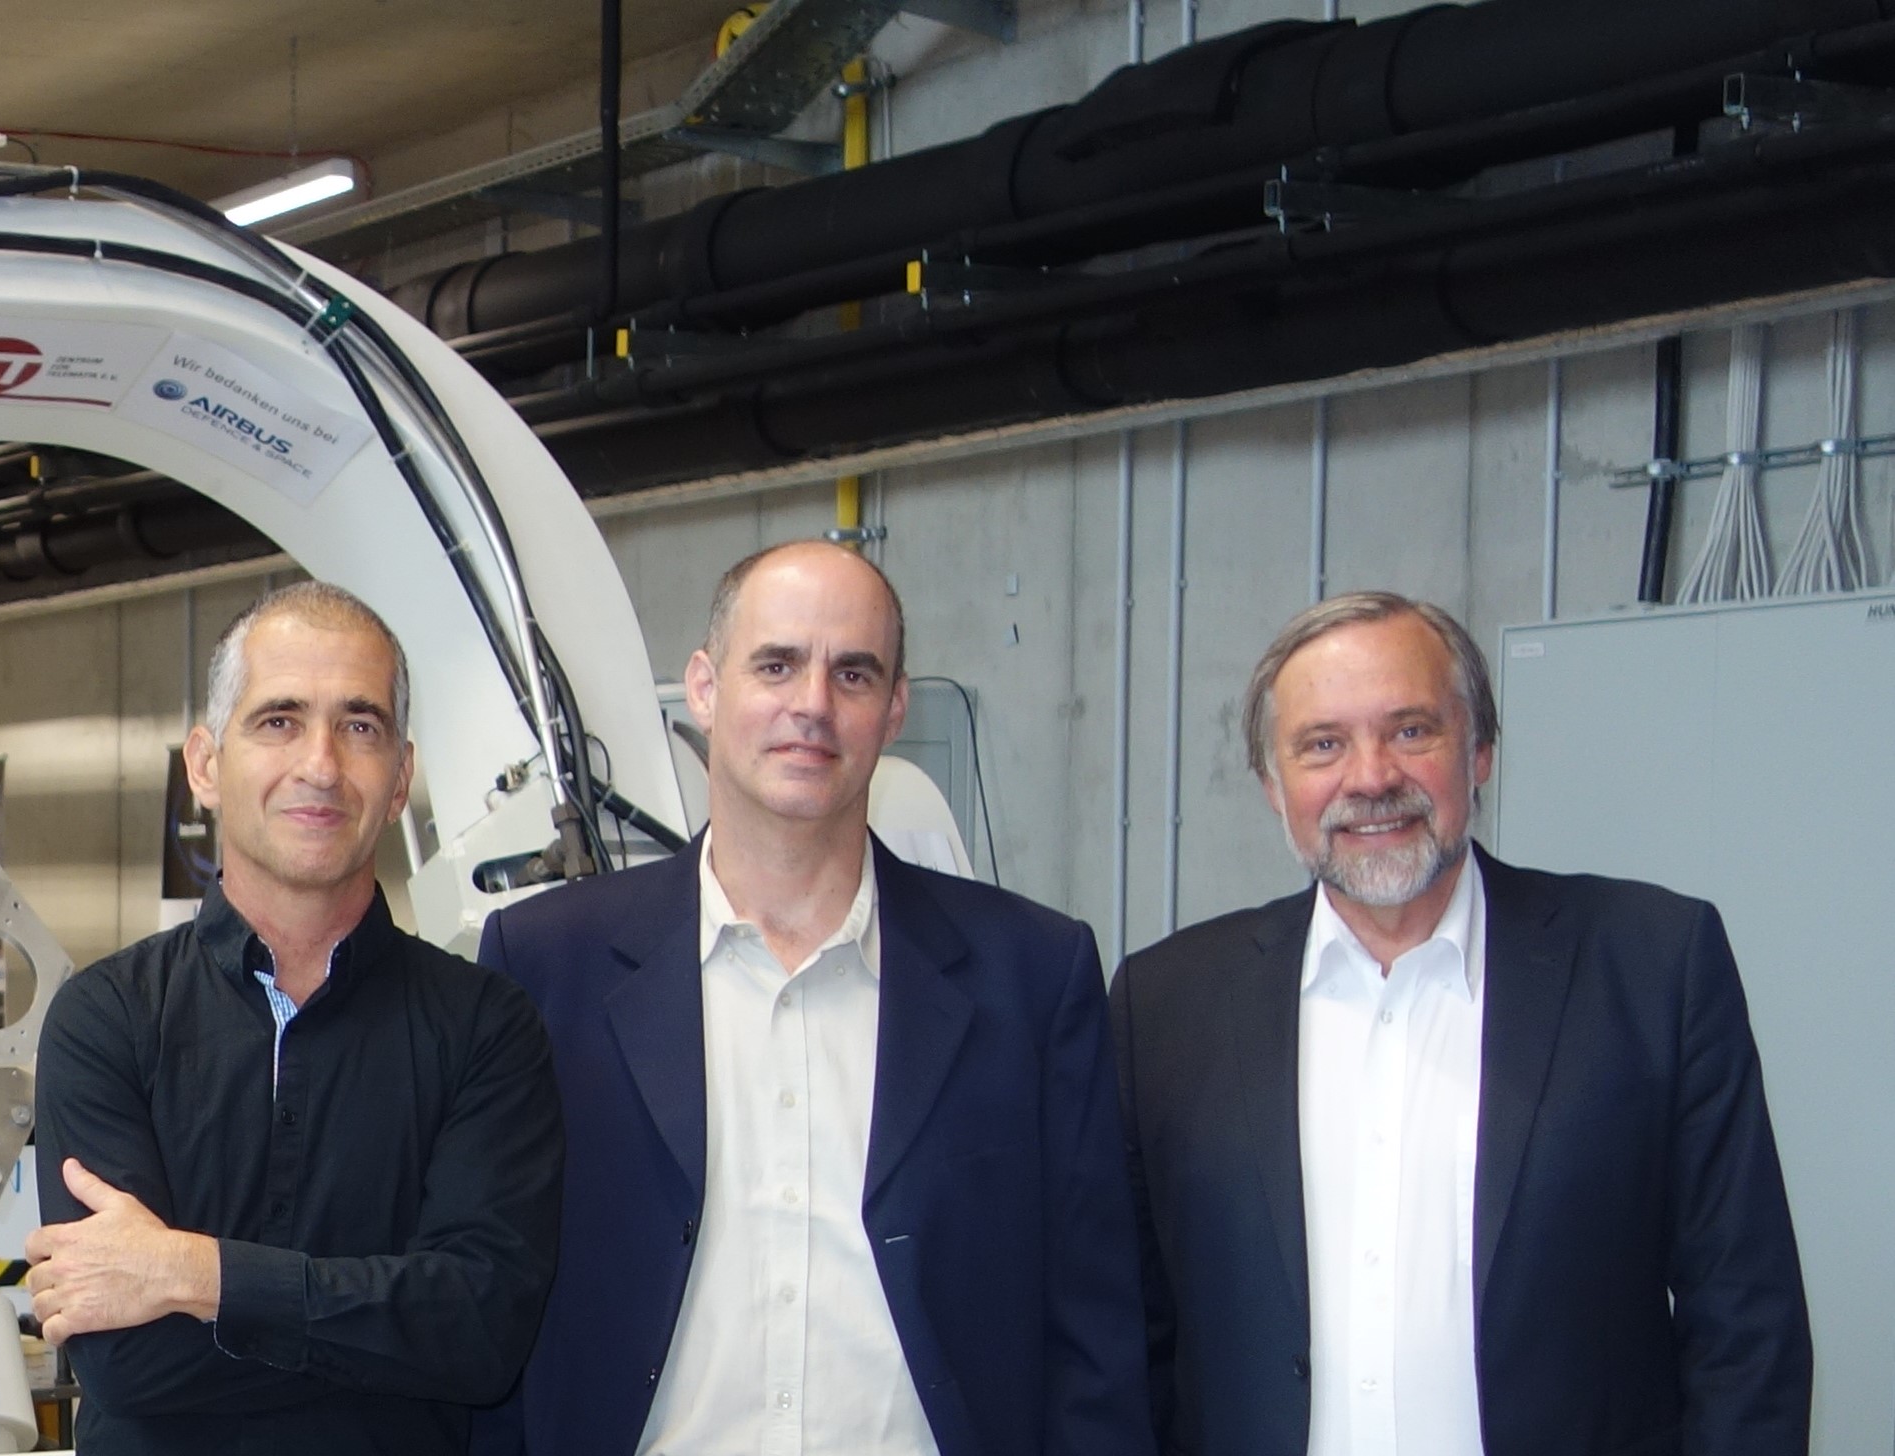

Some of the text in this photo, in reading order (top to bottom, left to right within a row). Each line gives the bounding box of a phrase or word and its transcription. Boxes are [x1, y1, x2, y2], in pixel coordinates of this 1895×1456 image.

[173, 354, 340, 446] Wir bedanken uns bei
[188, 396, 293, 454] AIRBUS
[180, 405, 250, 443] DEFENCE
[264, 448, 313, 479] SPACE
